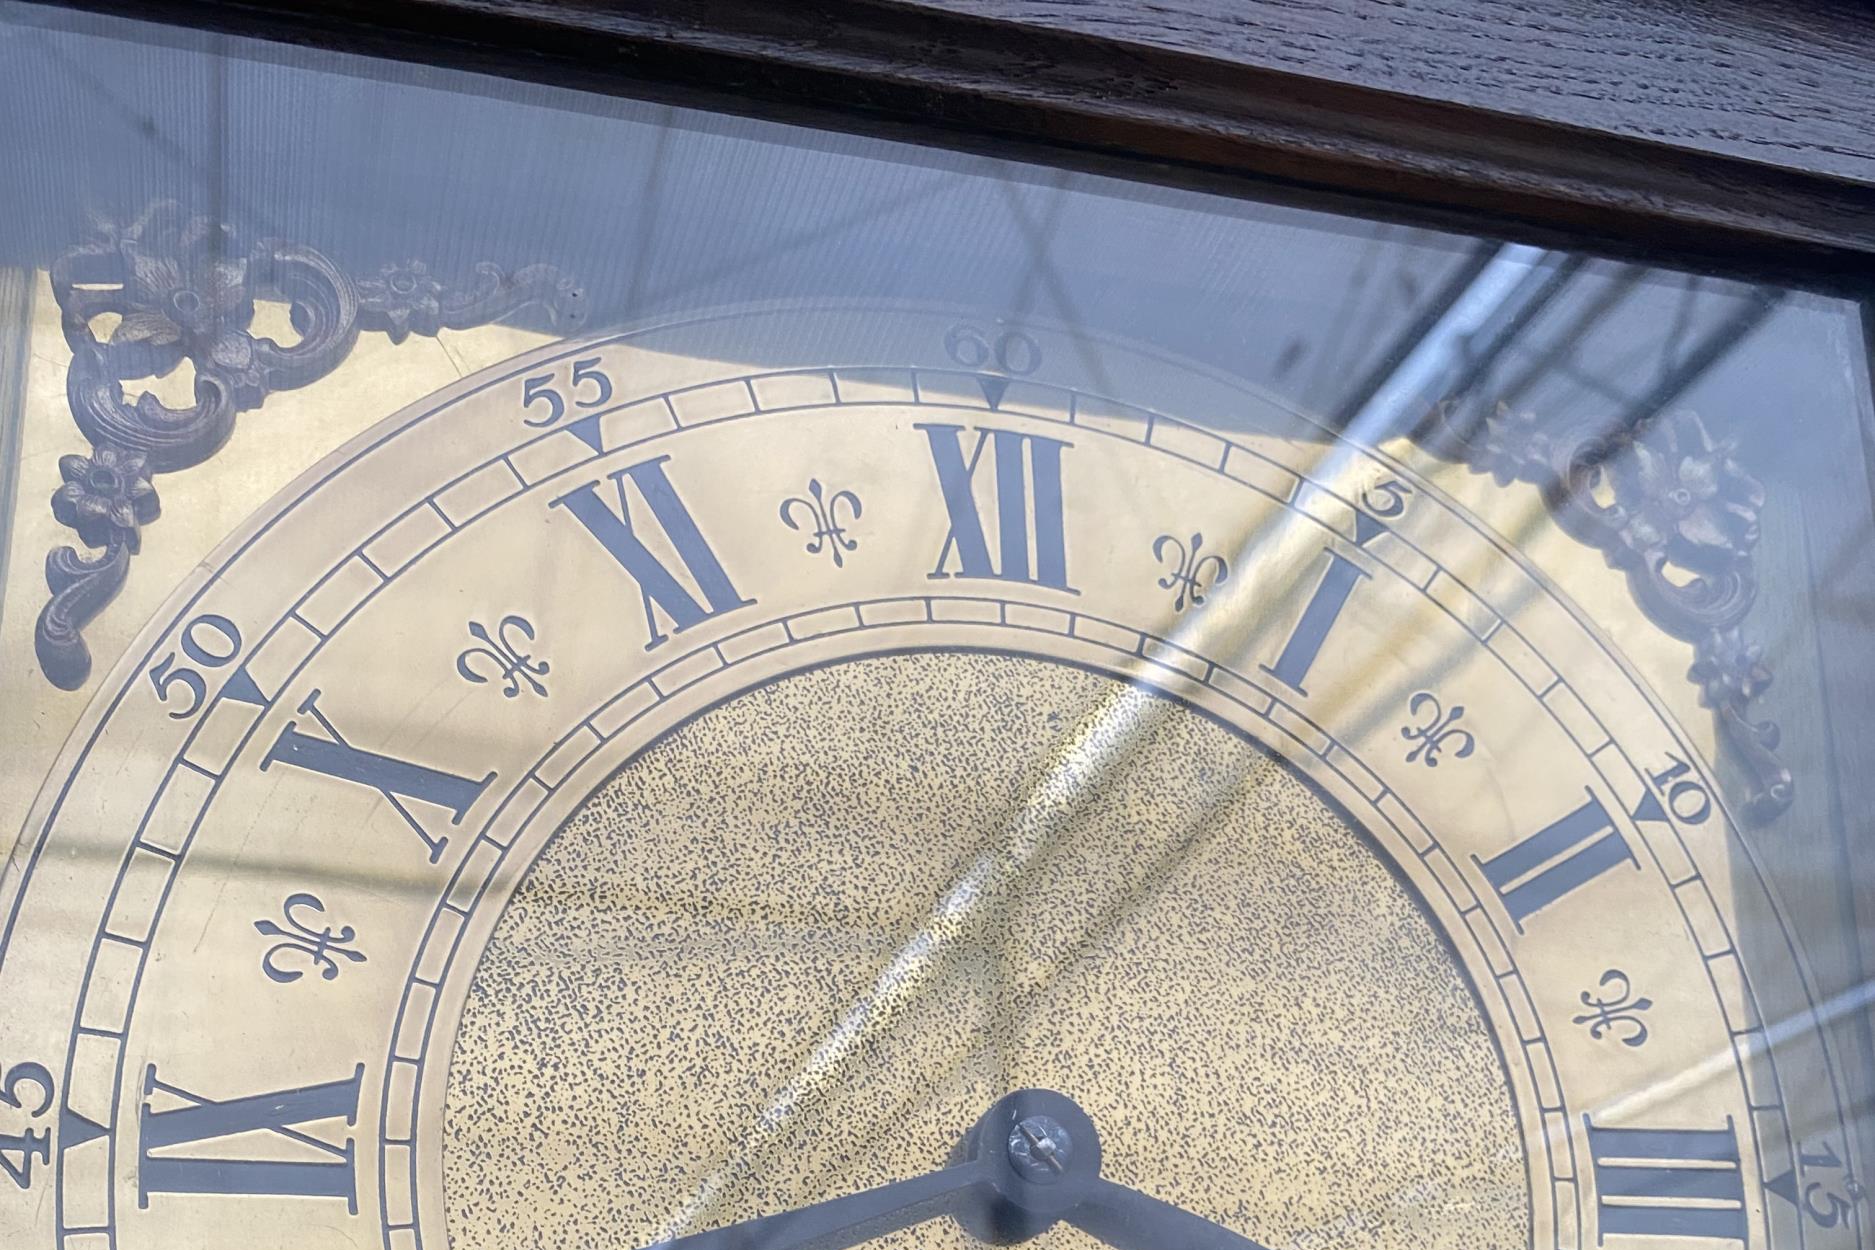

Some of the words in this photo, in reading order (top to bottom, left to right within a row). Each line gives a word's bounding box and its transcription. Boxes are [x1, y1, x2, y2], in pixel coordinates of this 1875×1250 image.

[522, 358, 613, 429] 55
[943, 326, 1042, 376] 60
[549, 453, 757, 652] XI
[914, 422, 1081, 596] XII
[1361, 478, 1406, 520] 5
[148, 612, 242, 721] 50
[1259, 546, 1374, 697] I
[261, 688, 498, 864] X
[1643, 750, 1711, 826] 10
[1470, 783, 1640, 936] II
[0, 1061, 56, 1190] 45
[138, 1061, 365, 1215] IX
[1801, 1141, 1853, 1232] 15
